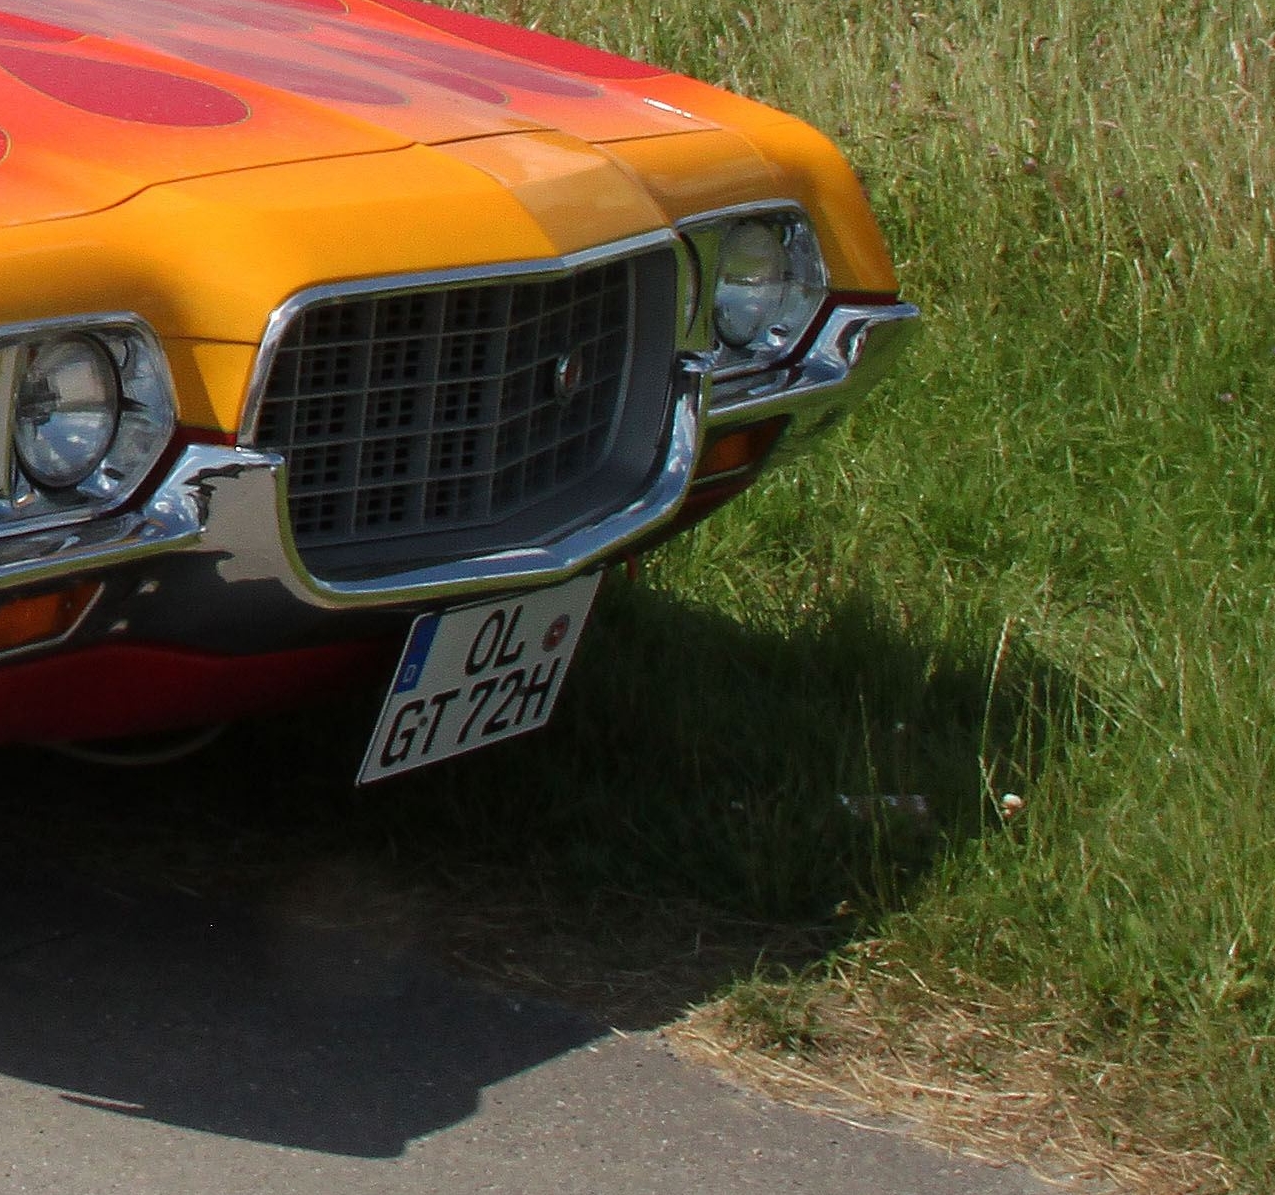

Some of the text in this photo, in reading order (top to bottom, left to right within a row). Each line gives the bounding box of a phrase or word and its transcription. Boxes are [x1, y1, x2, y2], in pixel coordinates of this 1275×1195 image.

[465, 604, 526, 677] OL
[379, 656, 562, 768] GT 72H
